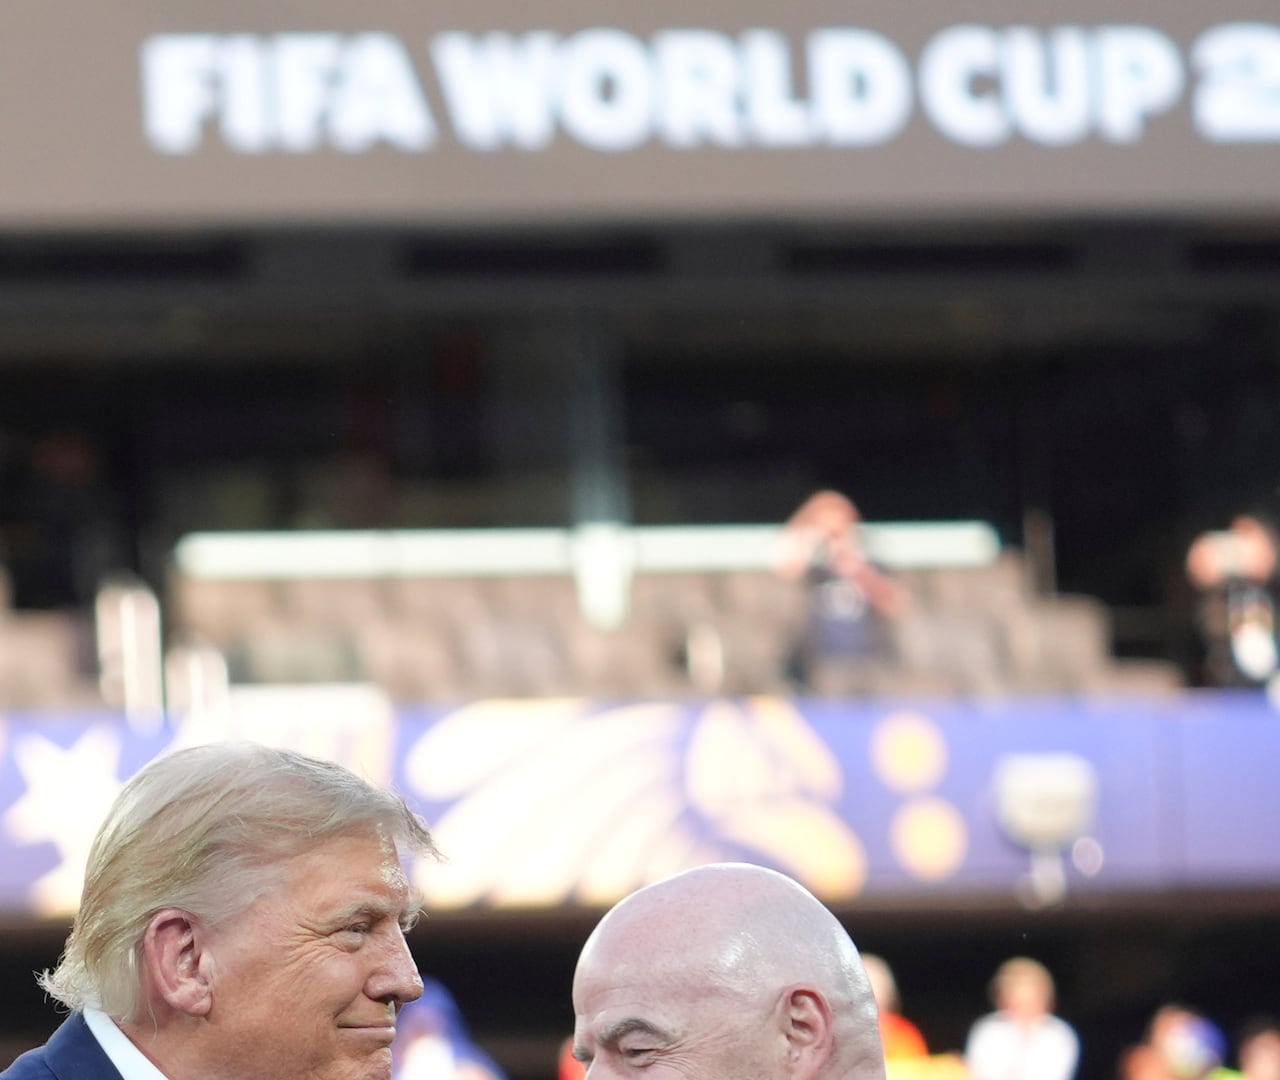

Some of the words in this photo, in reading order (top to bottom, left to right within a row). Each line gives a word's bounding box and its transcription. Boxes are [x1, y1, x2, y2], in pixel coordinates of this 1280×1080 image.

[142, 33, 433, 152] FIFA
[434, 28, 911, 148] WORLD
[918, 25, 1182, 146] CUP
[1193, 24, 1280, 142] 2
